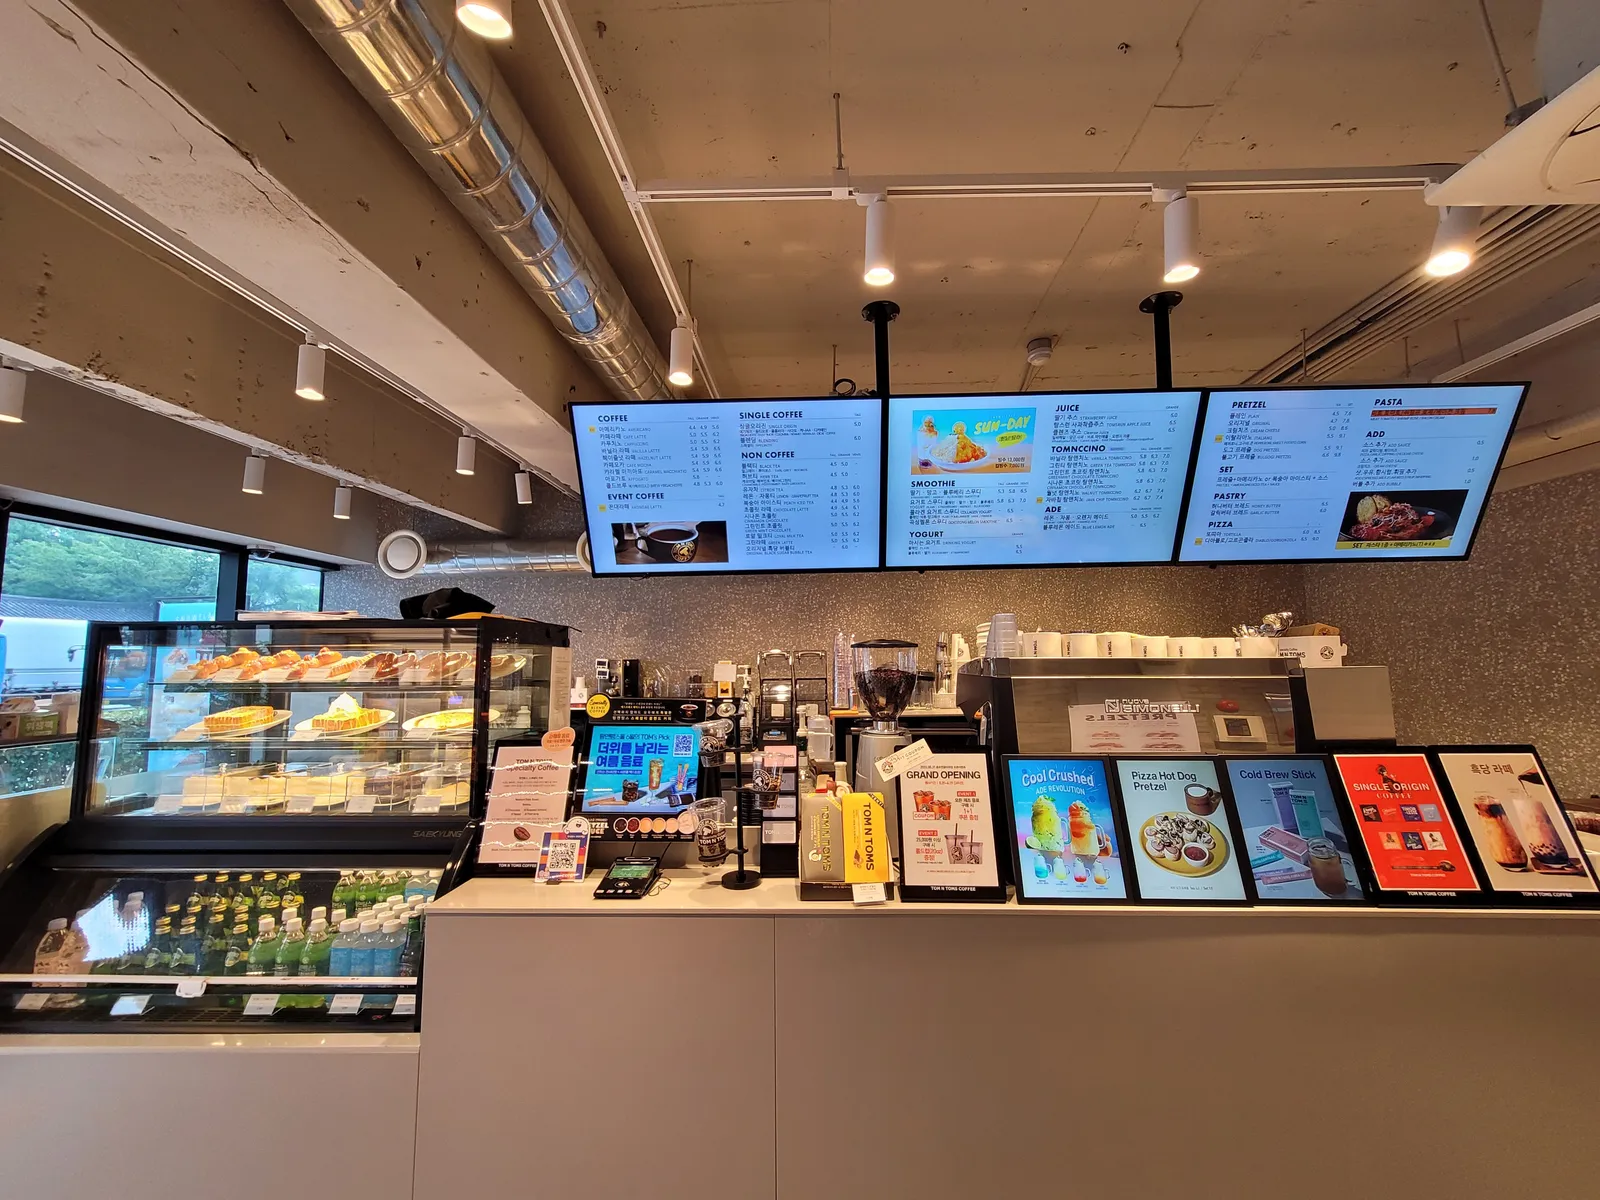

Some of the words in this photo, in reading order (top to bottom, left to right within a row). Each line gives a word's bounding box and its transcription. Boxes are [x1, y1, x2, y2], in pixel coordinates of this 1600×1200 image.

[974, 415, 1031, 435] SUN-DAY
[598, 743, 632, 754] 더위를
[635, 743, 669, 754] 날리는
[596, 756, 618, 767] 여름
[621, 756, 643, 767] 음료
[941, 771, 981, 779] OPENING
[1240, 770, 1262, 779] Cold
[1265, 770, 1290, 779] Brew
[1292, 770, 1316, 779] Stick
[1470, 764, 1490, 775] 흑당
[1494, 764, 1514, 774] 라떼
[1022, 770, 1046, 787] Cool
[1048, 769, 1094, 787] Crushed
[1132, 771, 1157, 780] Pizza
[1159, 772, 1175, 780] Hot
[1177, 772, 1196, 782] Dog
[1036, 786, 1047, 795] ADE
[1049, 785, 1086, 795] REVOLUTION
[1134, 782, 1167, 791] Pretzel
[822, 806, 830, 826] TOM
[863, 803, 871, 825] TOM
[864, 827, 872, 835] N
[822, 840, 831, 871] TOMS
[865, 838, 874, 871] TOMS
